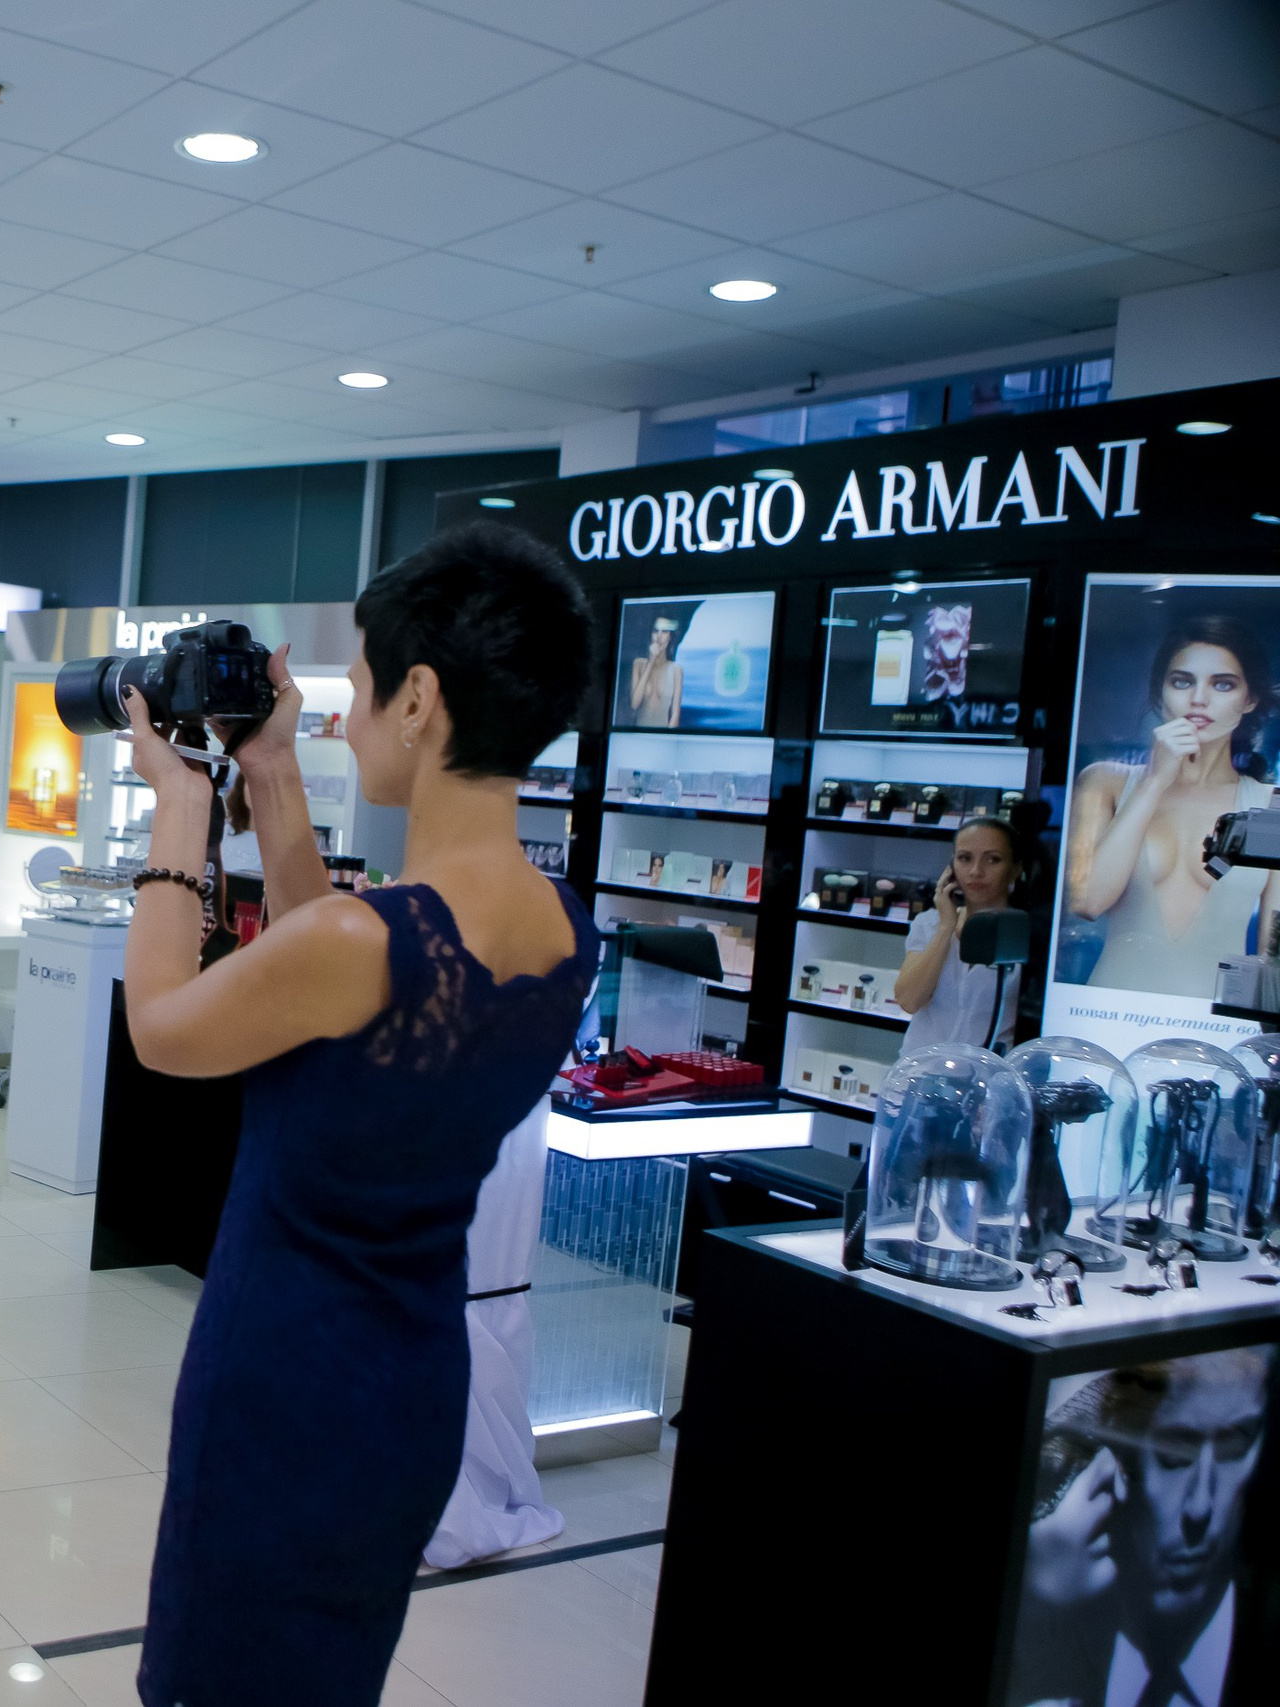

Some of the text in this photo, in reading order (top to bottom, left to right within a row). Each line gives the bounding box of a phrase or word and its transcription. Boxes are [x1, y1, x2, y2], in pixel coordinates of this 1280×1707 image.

[569, 438, 1147, 562] GIORGIO ARMANI
[116, 609, 139, 650] la
[29, 957, 39, 977] la
[40, 965, 77, 987] prairie
[1069, 1005, 1263, 1037] новая туалетная во
